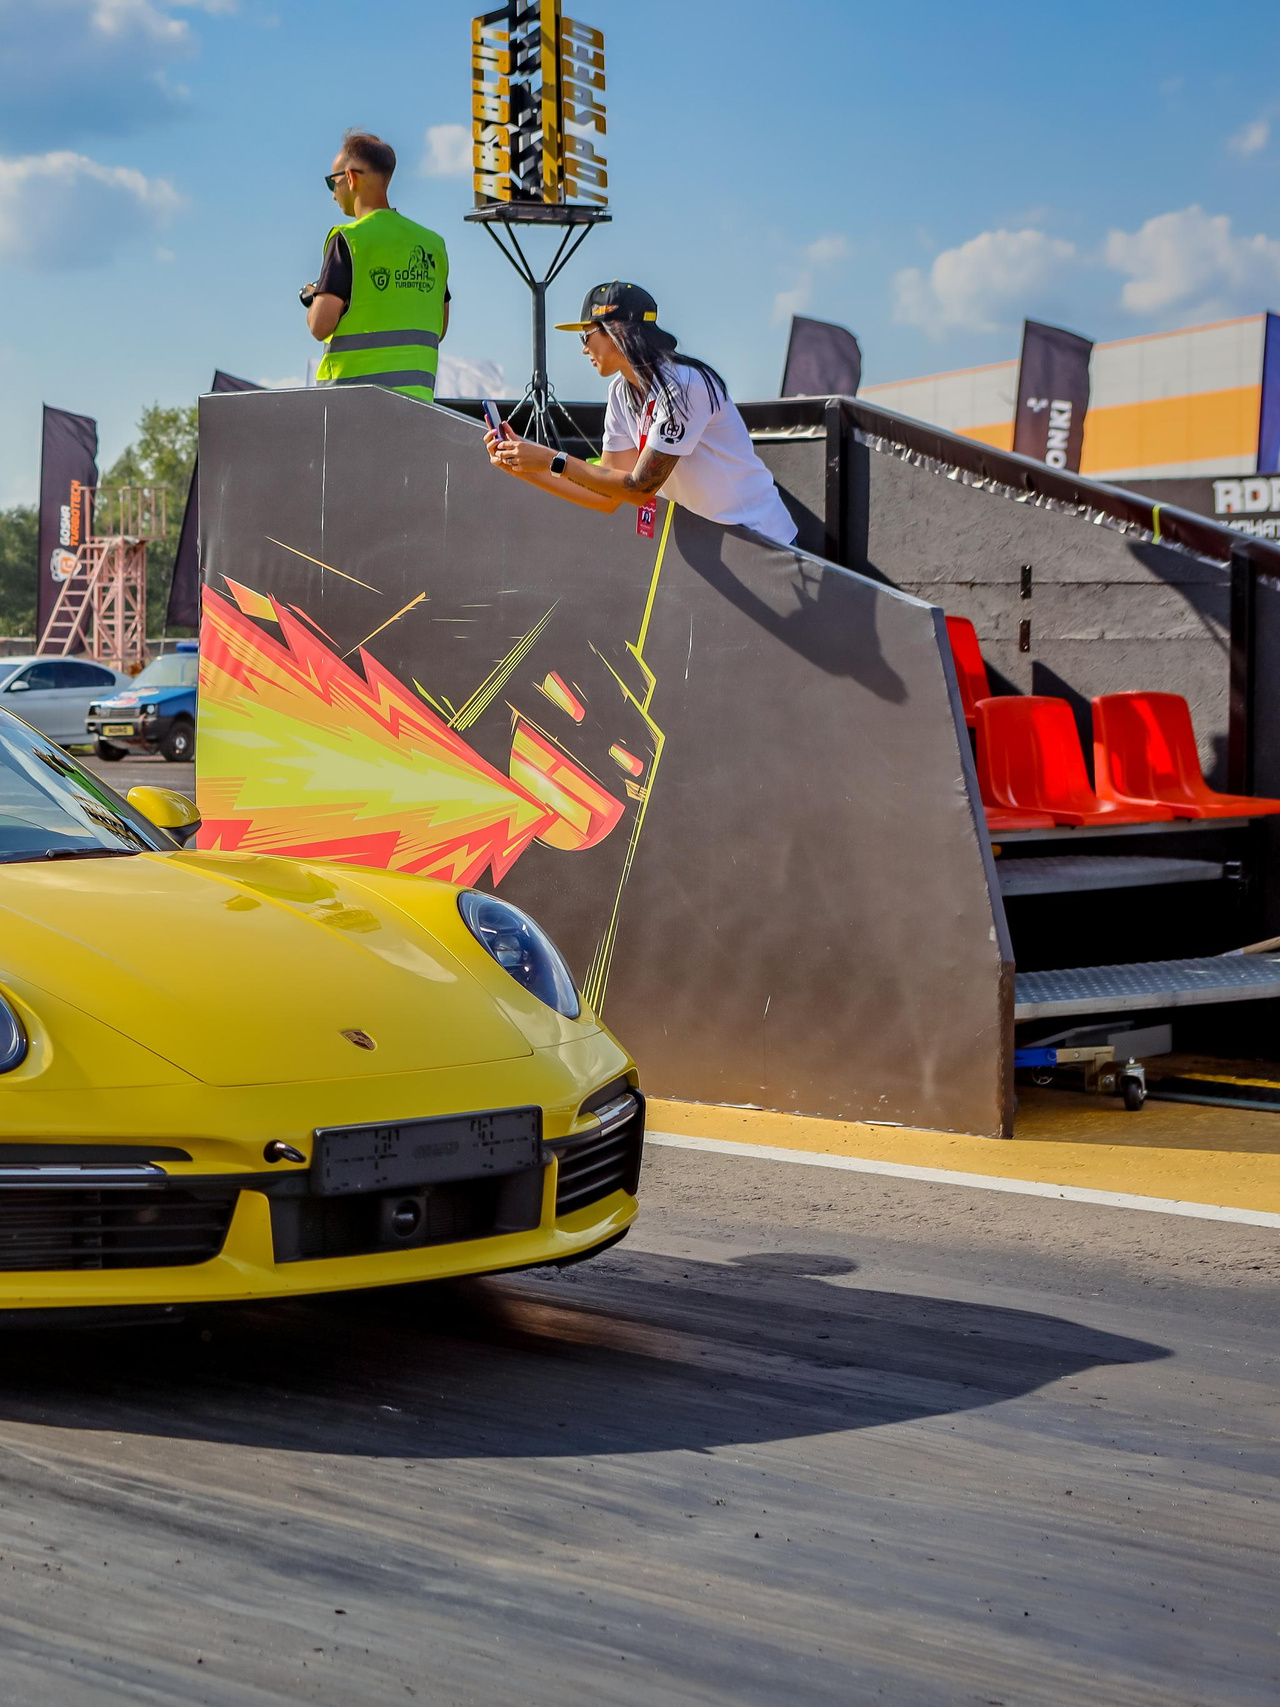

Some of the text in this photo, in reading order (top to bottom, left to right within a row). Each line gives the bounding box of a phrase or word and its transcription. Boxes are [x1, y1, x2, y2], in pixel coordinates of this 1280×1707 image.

[394, 270, 429, 280] GOSHA
[59, 505, 71, 547] GOSHA
[70, 480, 82, 547] TURBOTECH
